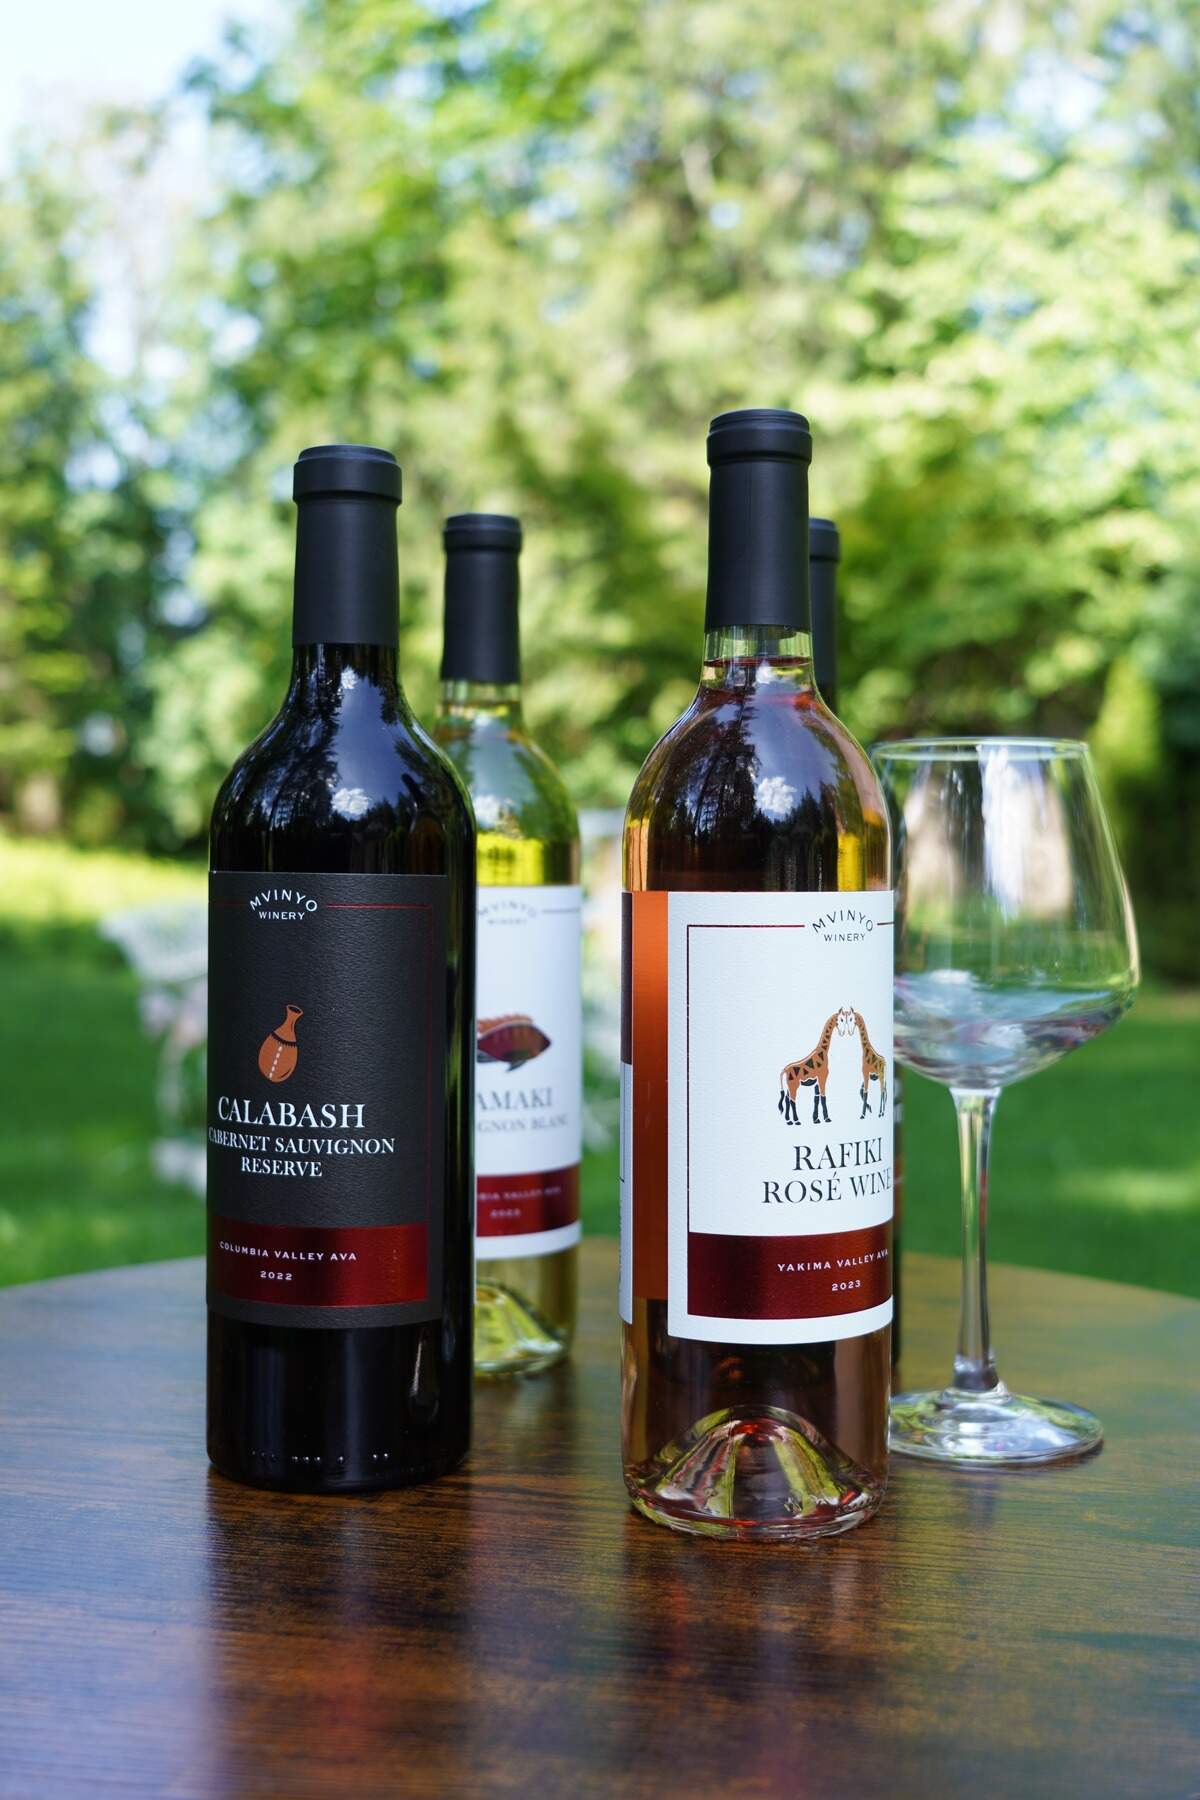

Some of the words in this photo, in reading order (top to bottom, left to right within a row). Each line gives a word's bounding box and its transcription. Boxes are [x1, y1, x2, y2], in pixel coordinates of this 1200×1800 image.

[249, 889, 318, 912] MVINYO
[258, 911, 305, 920] WINERY
[812, 909, 874, 933] MVINYO
[823, 933, 866, 942] WINERY
[217, 1095, 366, 1129] CALABASH
[208, 1126, 271, 1151] CABERNET
[274, 1137, 395, 1155] SAUVIGNON
[792, 1137, 883, 1171] RAFIKI
[241, 1156, 323, 1177] RESERVE
[761, 1171, 842, 1204] ROSÉ
[219, 1241, 269, 1258] COLUMBIA
[274, 1250, 324, 1261] VALLEY
[329, 1252, 357, 1261] AVA
[777, 1261, 832, 1272] YAKIMA
[836, 1253, 875, 1268] VALLEY
[259, 1270, 293, 1281] 2022
[831, 1279, 861, 1292] 2023
